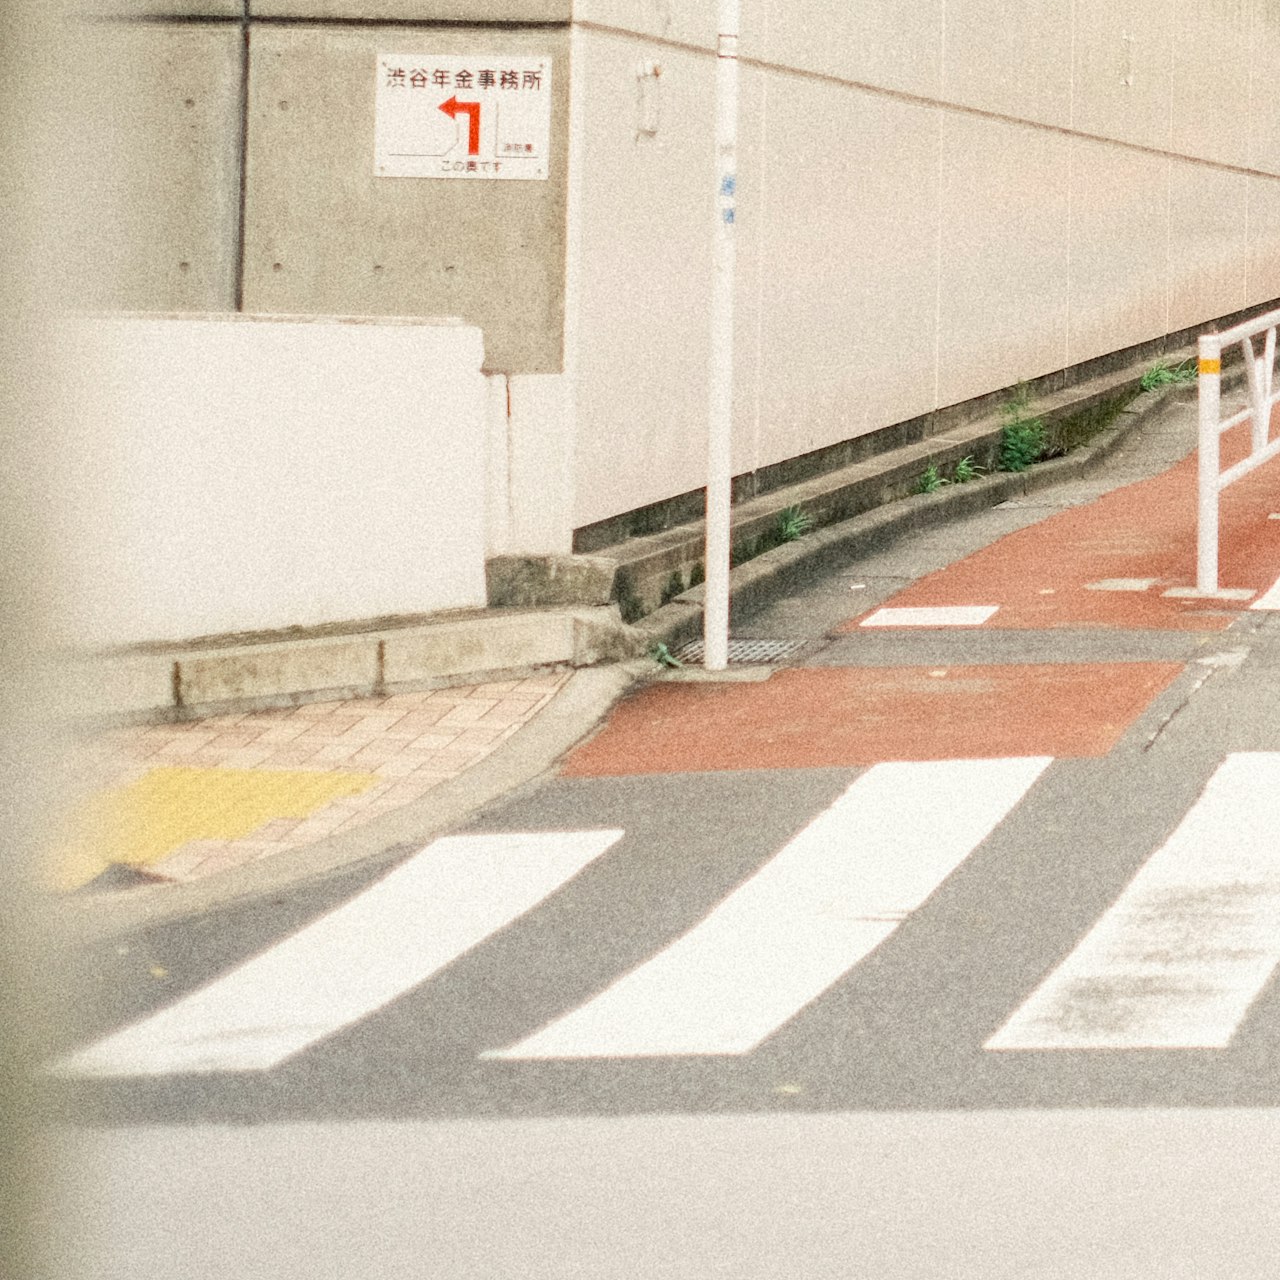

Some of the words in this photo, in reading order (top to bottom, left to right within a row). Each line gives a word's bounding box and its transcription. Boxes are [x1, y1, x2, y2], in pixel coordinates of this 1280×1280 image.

[386, 66, 543, 91] 渋谷年金事務所
[441, 159, 503, 174] この奥です
